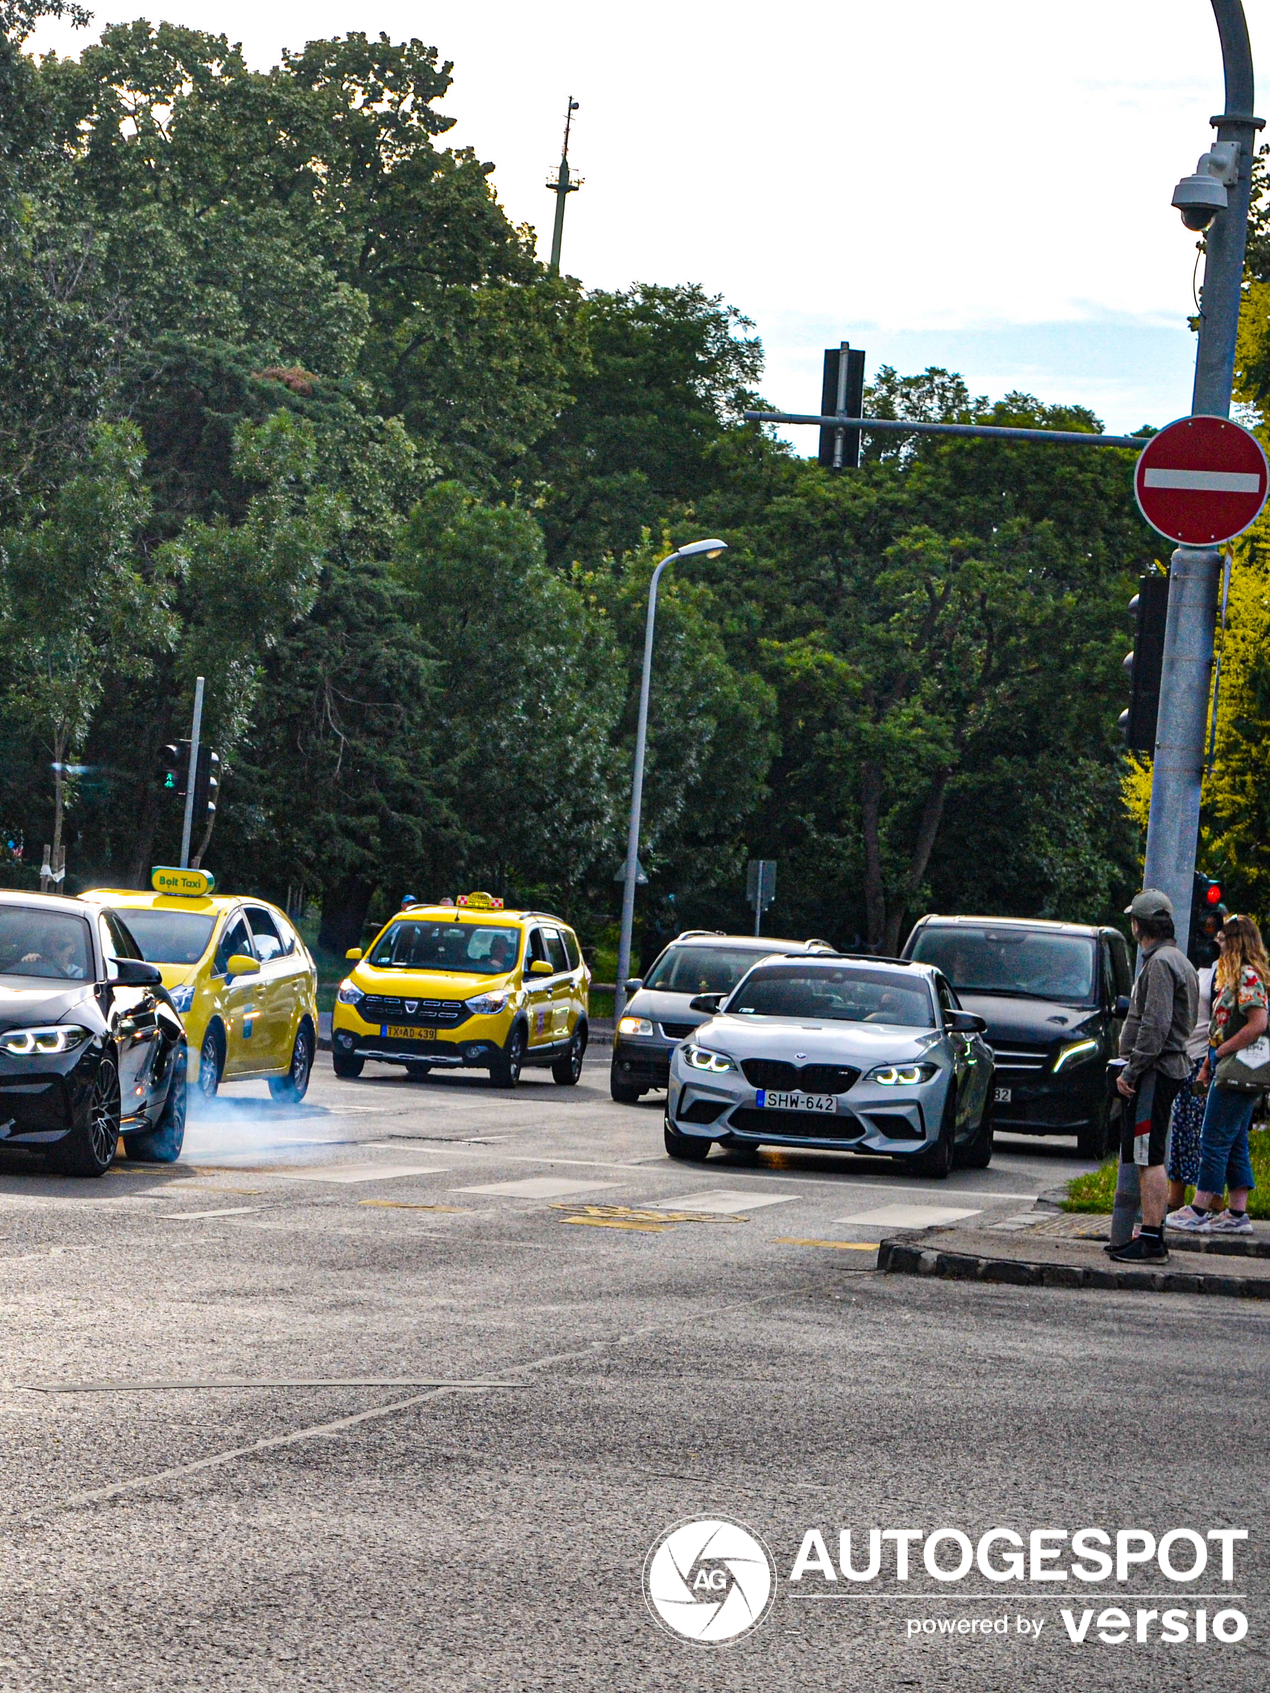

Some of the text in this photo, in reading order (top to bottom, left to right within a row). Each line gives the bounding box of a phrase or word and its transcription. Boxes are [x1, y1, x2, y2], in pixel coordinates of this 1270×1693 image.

[159, 875, 201, 889] Bolt Taxi
[767, 1093, 834, 1111] SHW-642
